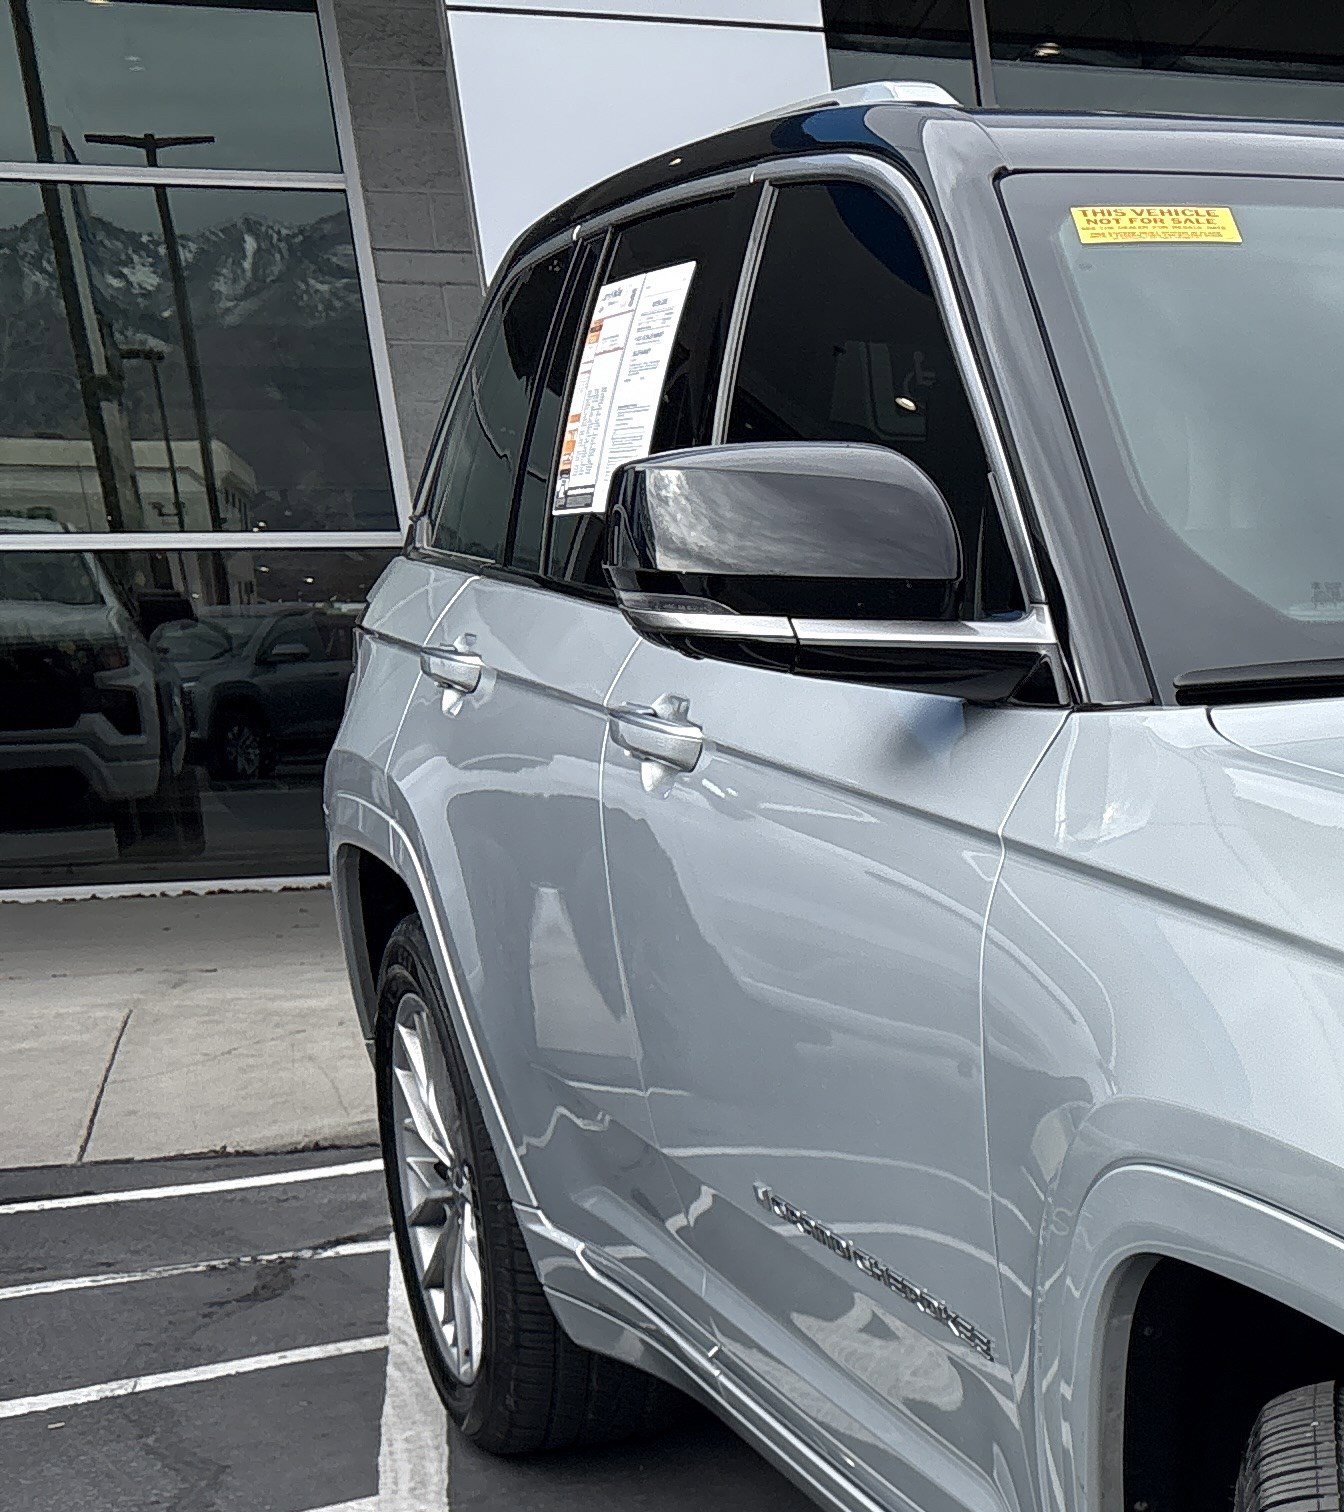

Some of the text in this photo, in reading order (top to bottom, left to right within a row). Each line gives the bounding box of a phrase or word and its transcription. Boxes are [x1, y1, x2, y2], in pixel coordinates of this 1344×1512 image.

[1079, 208, 1219, 218] THIS VEHICLE
[1086, 218, 1121, 226] NOT
